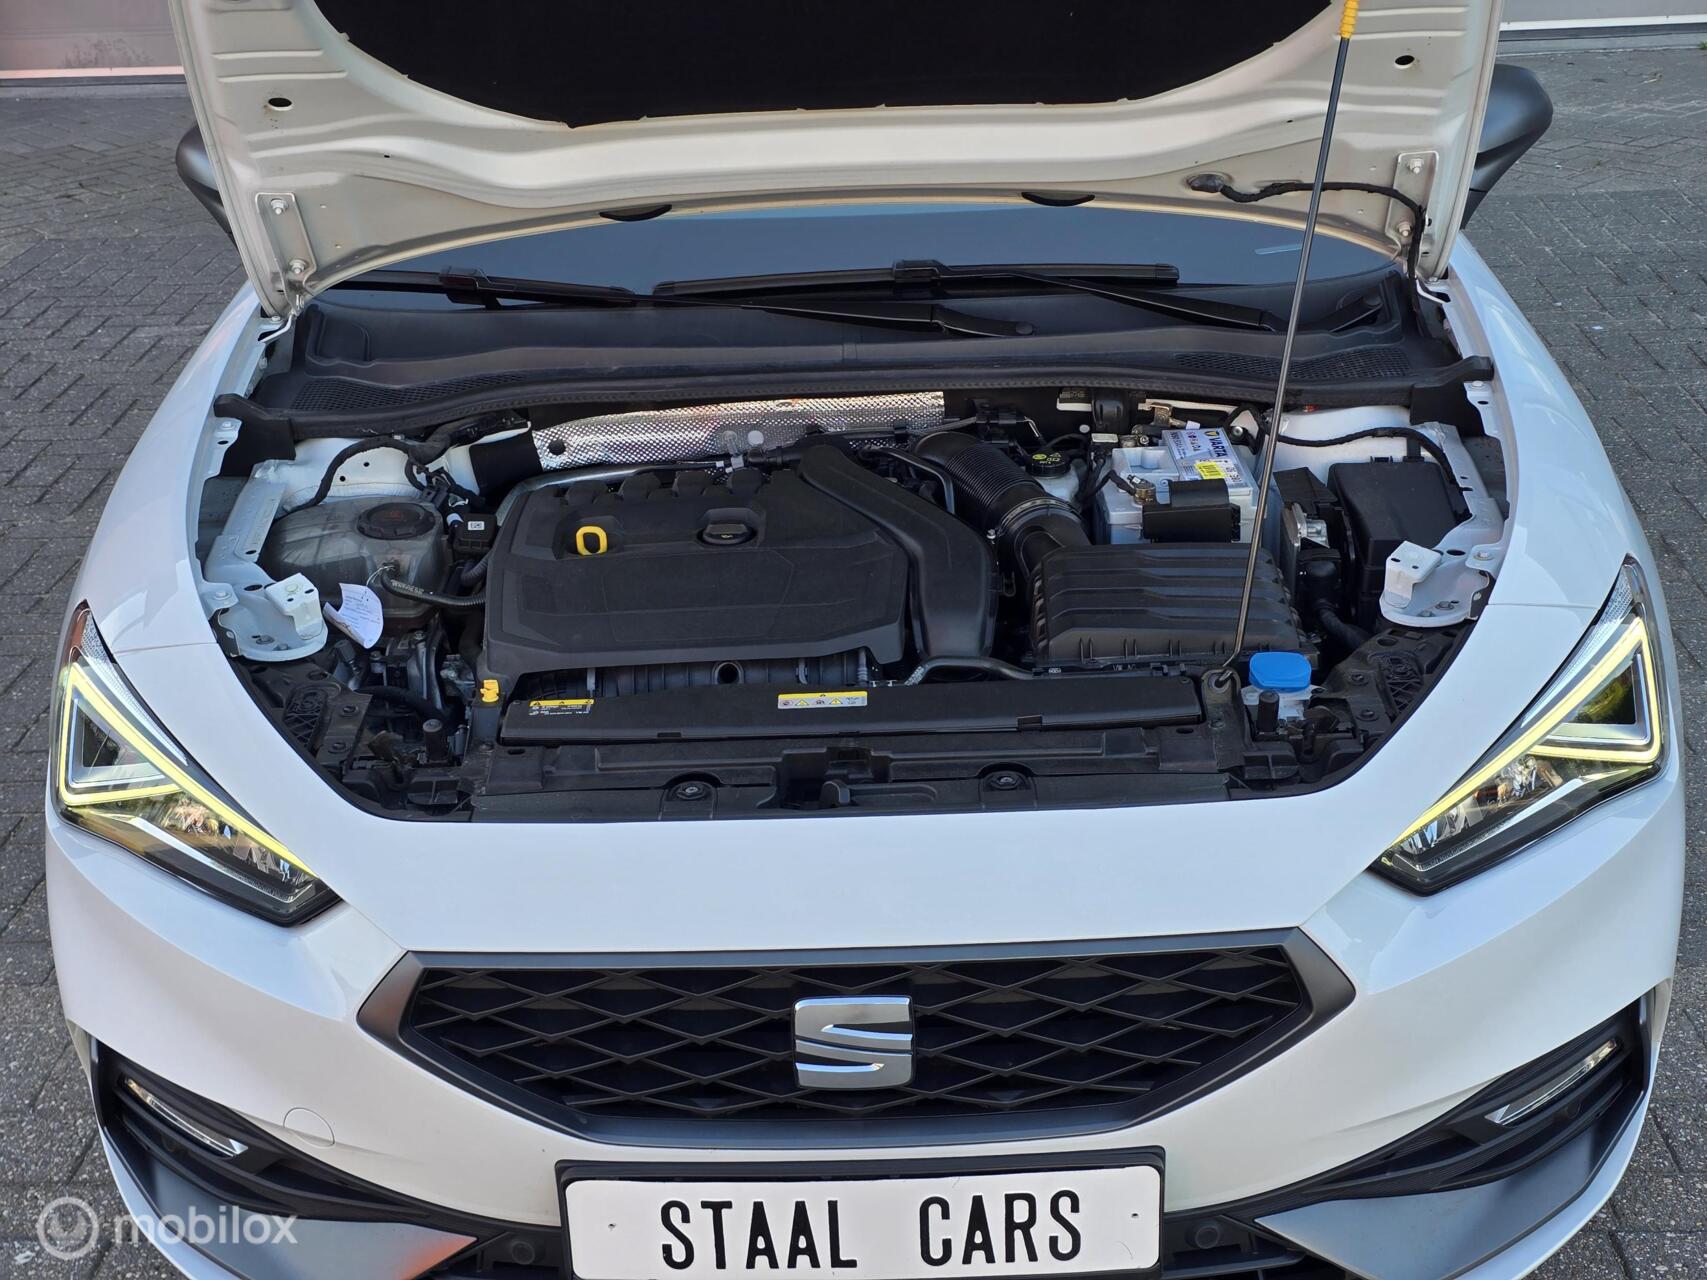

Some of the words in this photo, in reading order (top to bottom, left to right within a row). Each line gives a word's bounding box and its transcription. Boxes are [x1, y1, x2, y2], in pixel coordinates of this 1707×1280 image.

[1209, 437, 1228, 458] VARTA
[660, 1199, 858, 1270] STAAL
[918, 1189, 1082, 1267] CARS
